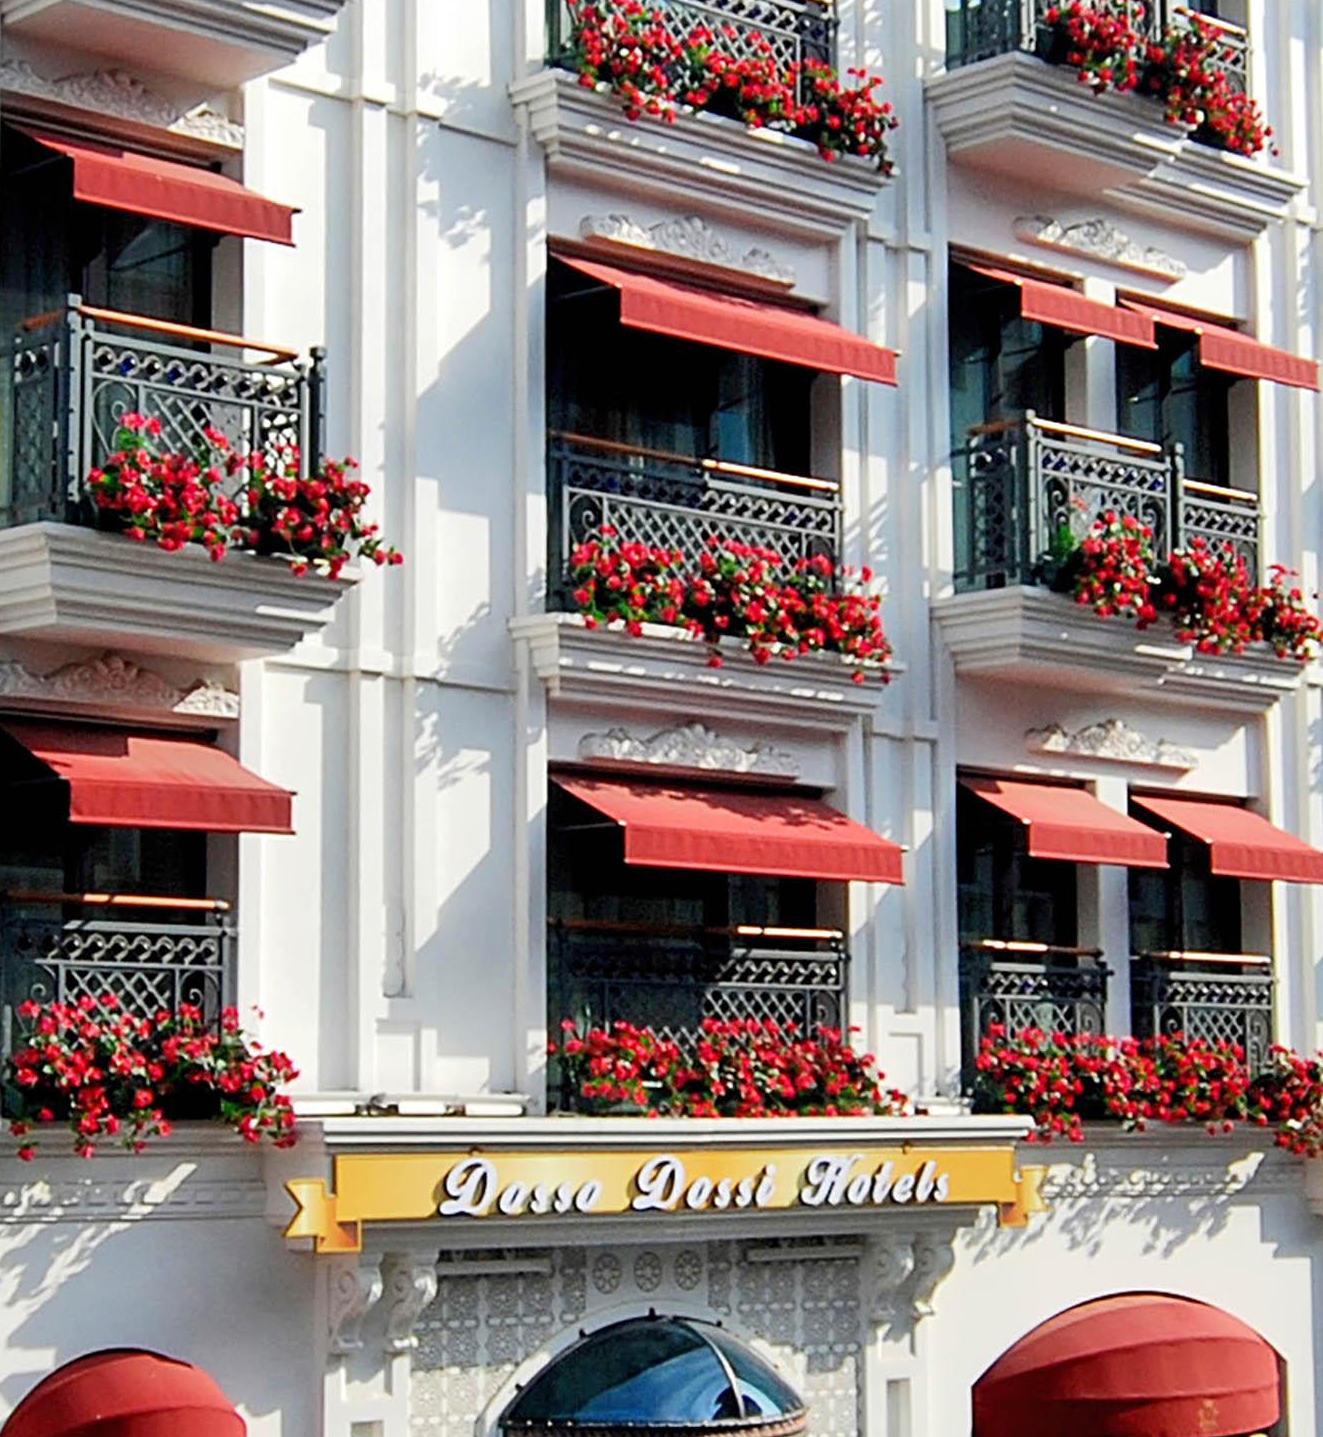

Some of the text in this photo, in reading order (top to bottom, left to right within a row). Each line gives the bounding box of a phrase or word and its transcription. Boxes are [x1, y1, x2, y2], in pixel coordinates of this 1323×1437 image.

[438, 1153, 950, 1216] Dosso Dossi Hotels
